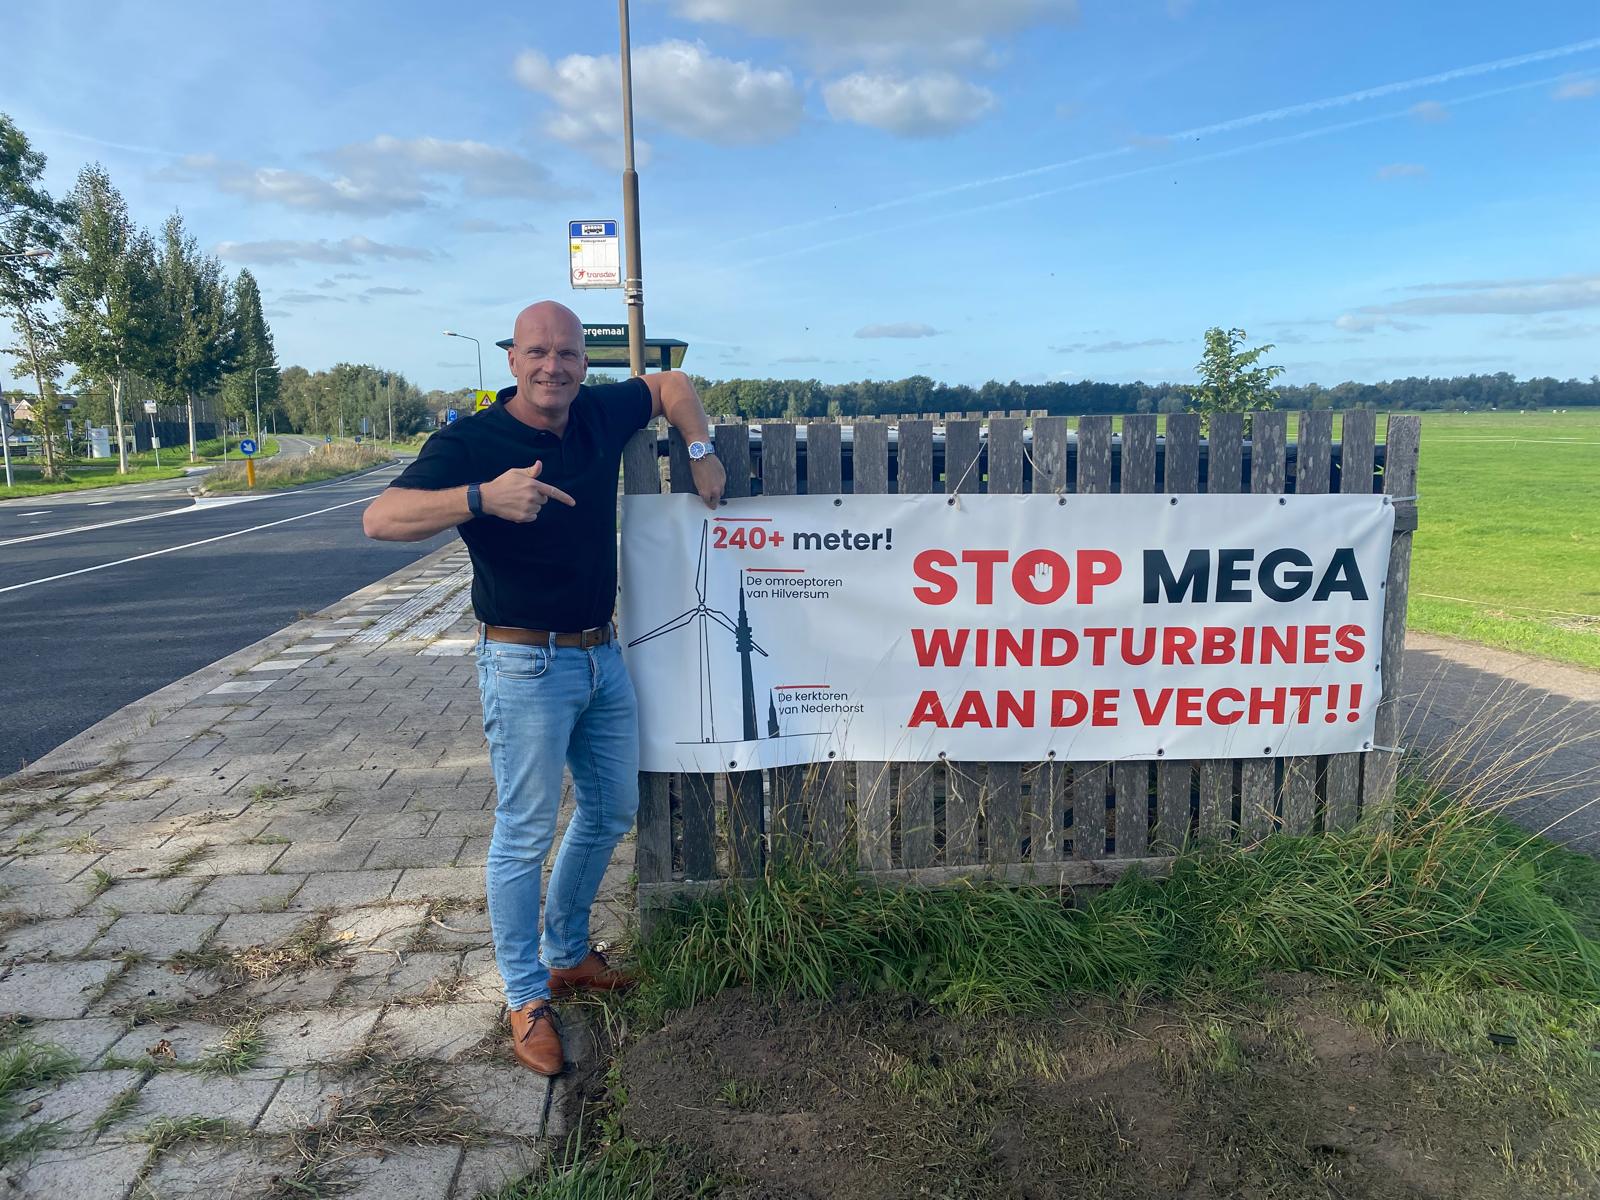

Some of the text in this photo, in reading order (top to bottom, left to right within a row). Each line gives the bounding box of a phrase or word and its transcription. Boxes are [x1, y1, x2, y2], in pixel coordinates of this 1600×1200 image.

[583, 327, 625, 337] ergemaal
[713, 526, 892, 551] 240+ meter!
[746, 576, 843, 589] De omroeptoren
[913, 547, 1369, 606] STOP MEGA
[746, 588, 829, 599] van Hilversum
[911, 624, 1366, 667] WINDTURBINES
[778, 691, 848, 702] De kerktoren
[779, 703, 864, 715] van Nederhorst
[908, 683, 1364, 729] AAN DE VECHT!!
